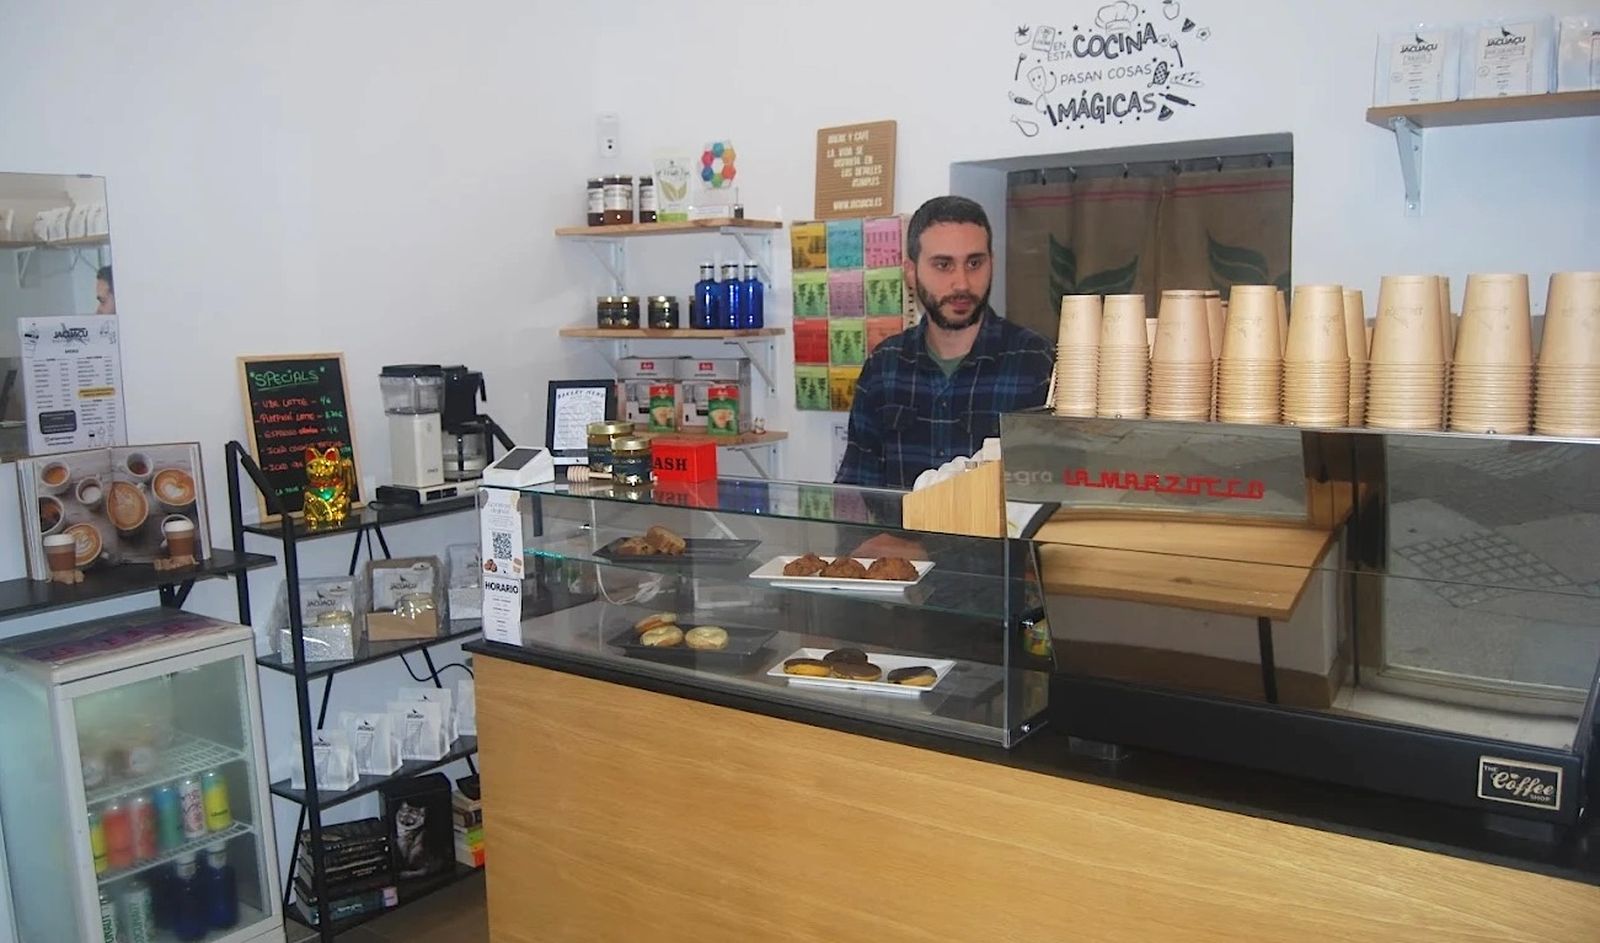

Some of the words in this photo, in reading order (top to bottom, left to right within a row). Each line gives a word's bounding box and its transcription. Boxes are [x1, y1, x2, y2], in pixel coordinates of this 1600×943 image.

[1053, 41, 1067, 51] EN
[1072, 22, 1158, 59] COCINA
[1047, 50, 1073, 61] ESTA
[1060, 70, 1103, 86] PASAN
[1107, 63, 1153, 80] COSAS
[1057, 90, 1157, 124] MÁGICAS
[1063, 467, 1088, 486] LA
[485, 580, 519, 595] HORARIO
[1483, 765, 1498, 773] THE
[1490, 771, 1554, 797] Coffee
[1530, 794, 1552, 802] SHOP
